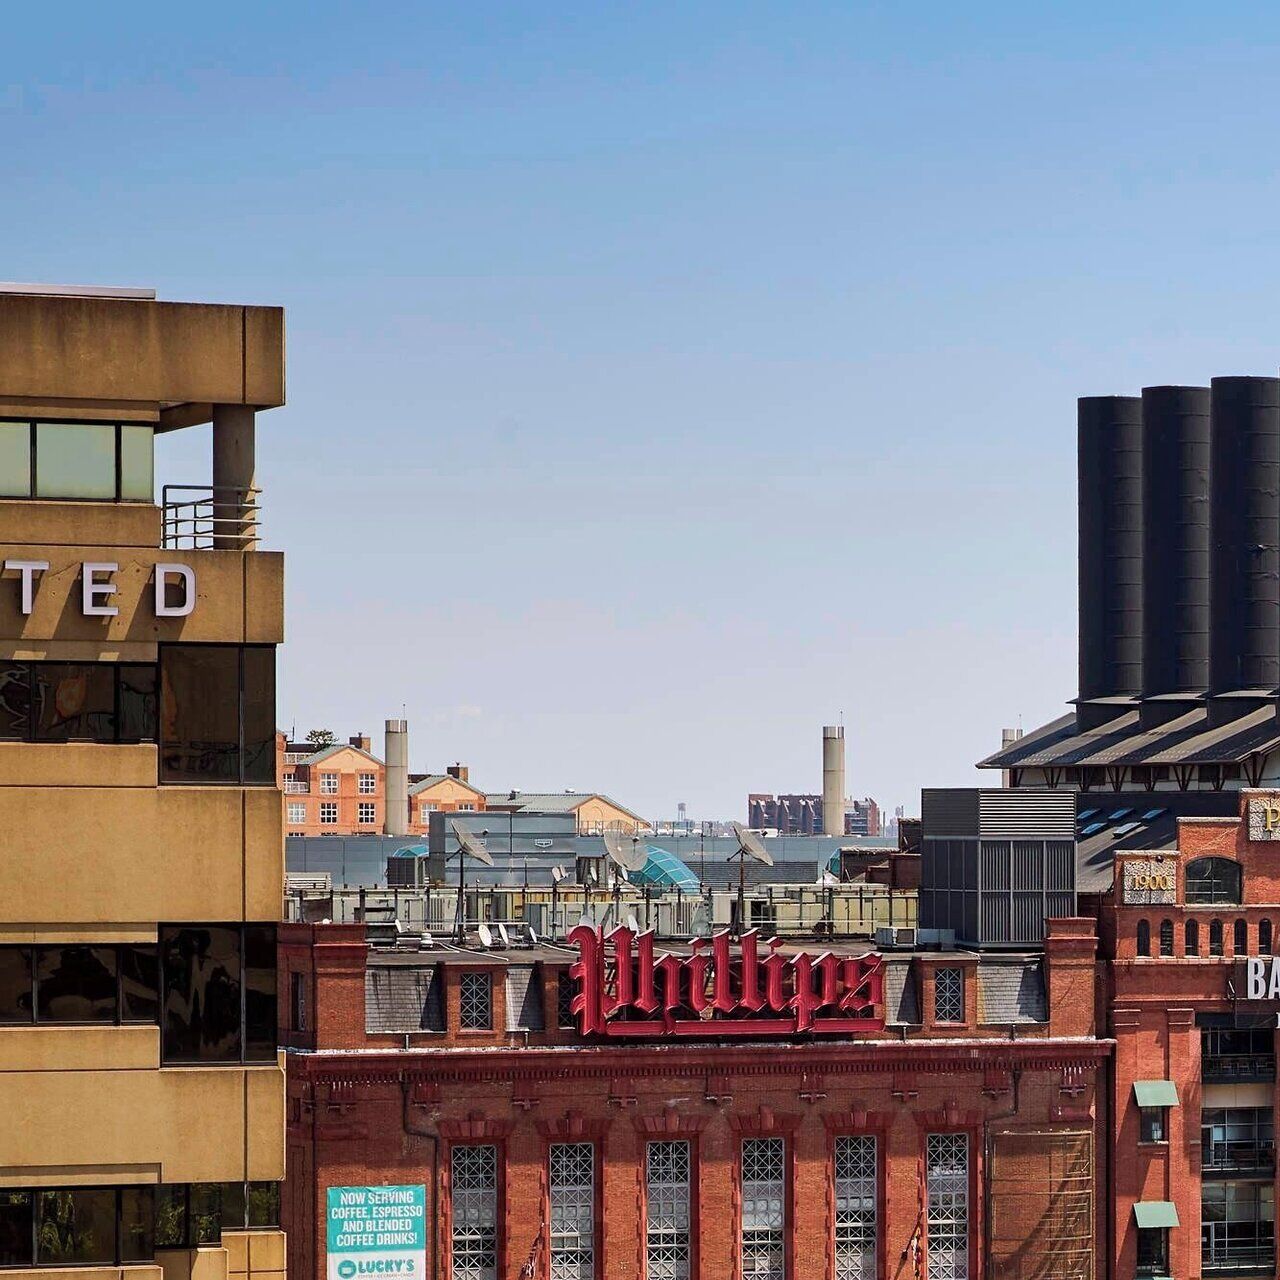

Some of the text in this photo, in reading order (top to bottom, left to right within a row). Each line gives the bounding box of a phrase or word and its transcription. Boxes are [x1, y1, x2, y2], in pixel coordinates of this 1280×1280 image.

[5, 560, 196, 617] TED
[1133, 875, 1168, 891] 1900
[566, 924, 885, 1035] Phillips
[341, 1191, 413, 1205] NOW SERVING
[372, 1206, 422, 1218] ESPRESSO
[342, 1219, 412, 1232] AND BLENDED
[337, 1233, 417, 1246] COFFEE DRINKS!
[358, 1259, 415, 1273] LUCKY'S
